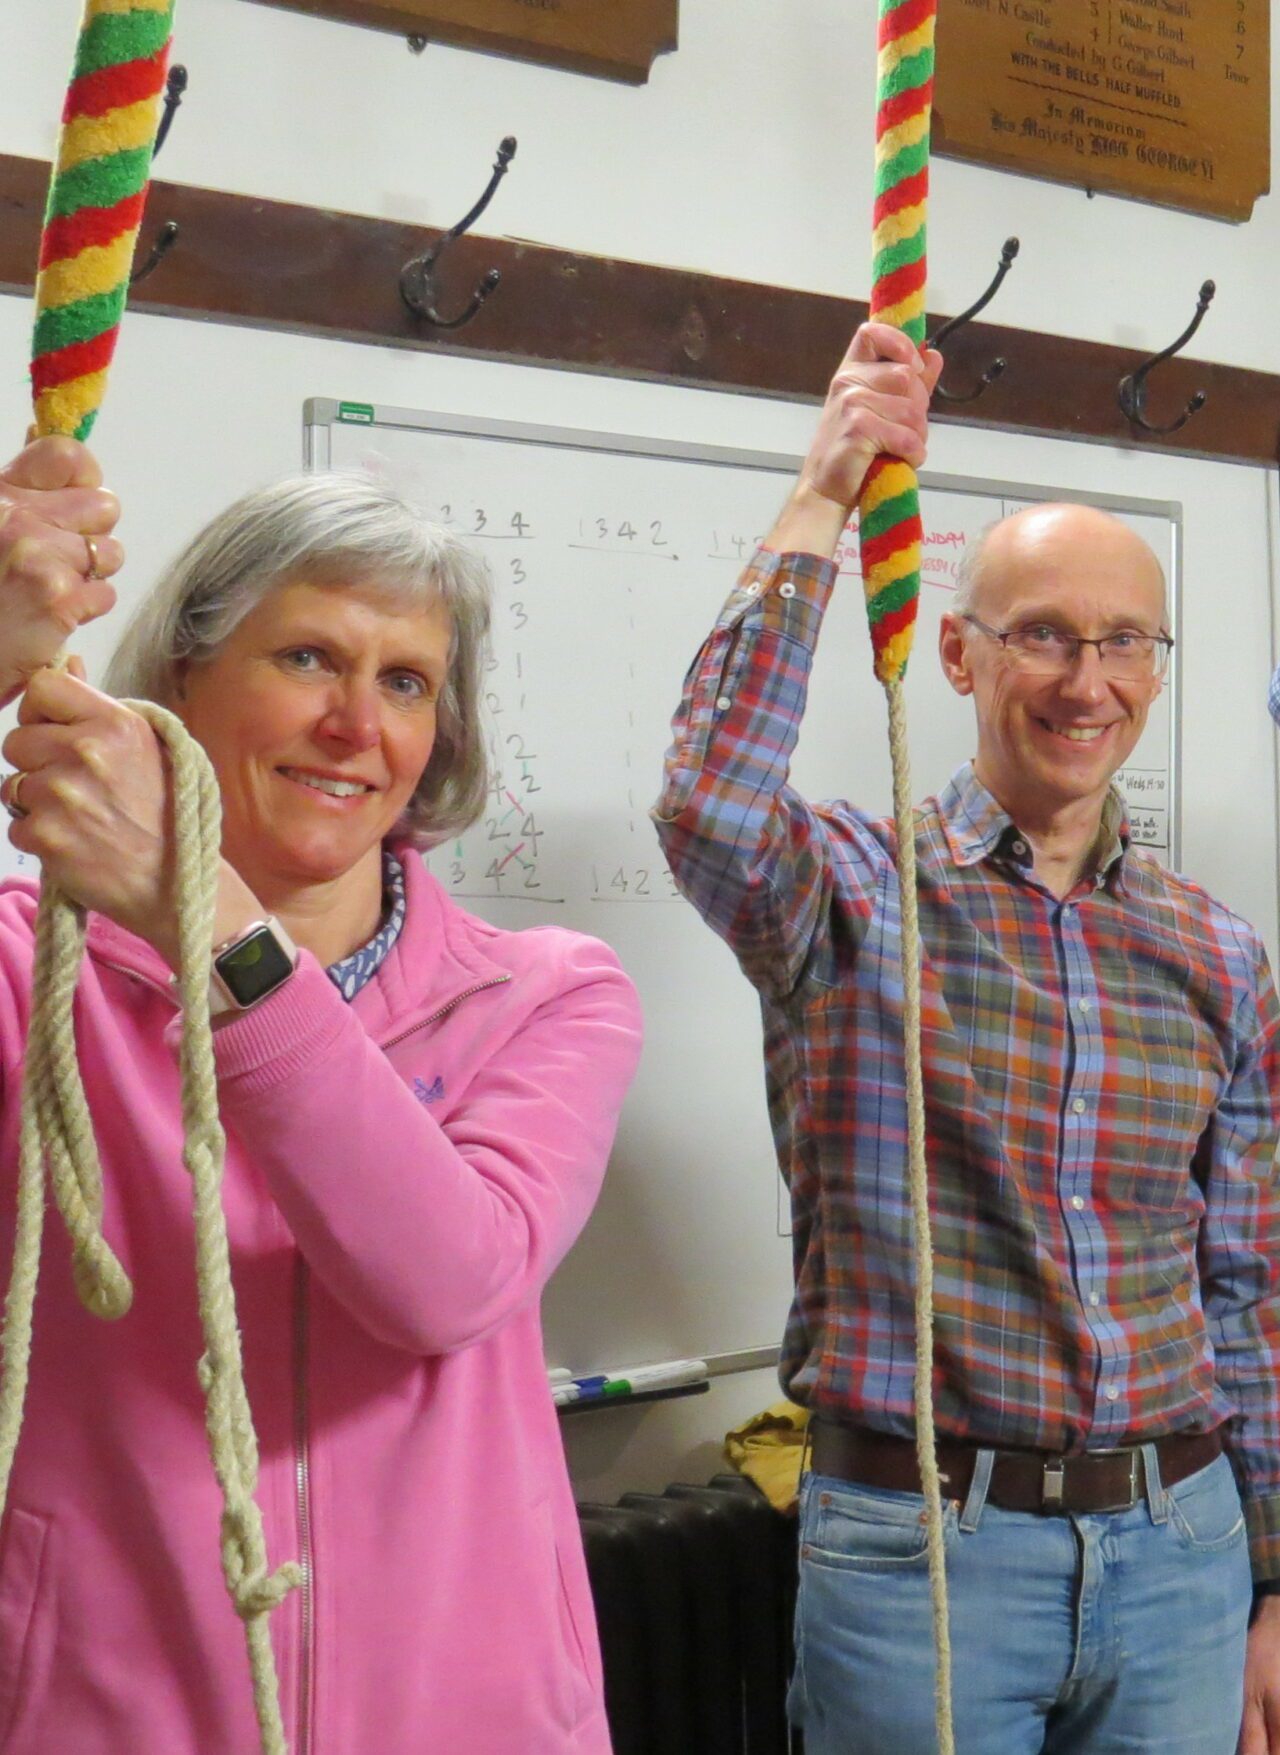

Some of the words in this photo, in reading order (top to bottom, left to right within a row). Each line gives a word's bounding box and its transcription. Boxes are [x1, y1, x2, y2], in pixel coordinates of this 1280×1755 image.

[1236, 20, 1246, 36] 6
[1025, 31, 1086, 62] Conducted
[1091, 50, 1106, 71] by
[1126, 58, 1165, 83] Gilbert
[1118, 34, 1156, 61] George
[1156, 45, 1196, 71] Gilbert
[1236, 44, 1245, 60] 7
[1010, 52, 1038, 70] WITH
[1042, 59, 1061, 76] THE
[1065, 66, 1100, 86] BELLS
[1105, 78, 1132, 96] HALF
[1135, 85, 1182, 109] MUFFLED
[990, 107, 1016, 133] His
[1019, 117, 1085, 154] Majesty
[1044, 98, 1063, 119] In
[1069, 105, 1147, 140] Memoriam
[474, 508, 488, 532] 3
[510, 511, 531, 537] 4
[509, 557, 528, 585] 3
[509, 601, 529, 630] 3
[506, 733, 537, 760] 2
[519, 774, 542, 794] 2
[485, 818, 511, 841] 2
[520, 811, 545, 858] 4
[17, 854, 25, 866] 2
[449, 861, 467, 884] 3
[484, 857, 505, 892] 4
[522, 863, 541, 889] 2
